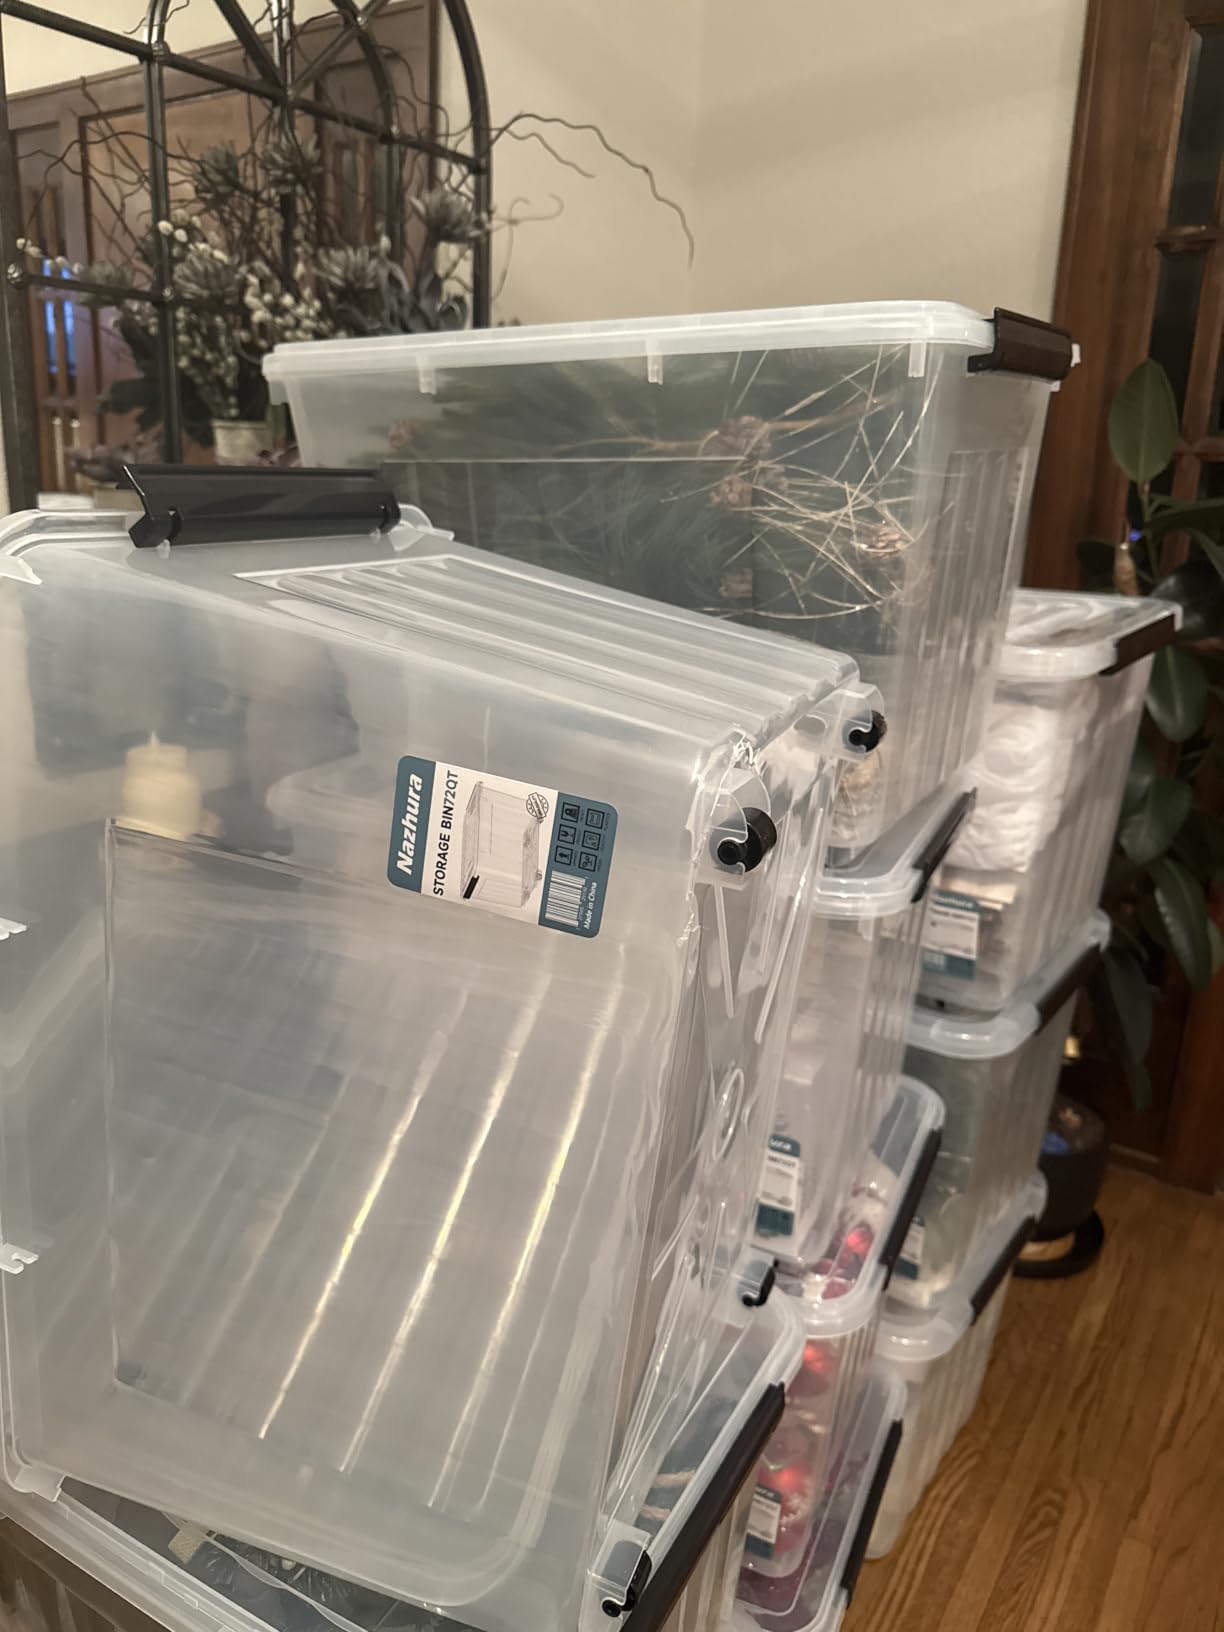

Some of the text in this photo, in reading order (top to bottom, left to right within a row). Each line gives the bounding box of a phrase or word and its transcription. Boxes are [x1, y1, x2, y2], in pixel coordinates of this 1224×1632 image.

[396, 773, 423, 876] Nazhura
[433, 770, 459, 896] STORAGE BIN72QT
[583, 882, 598, 930] Made in China
